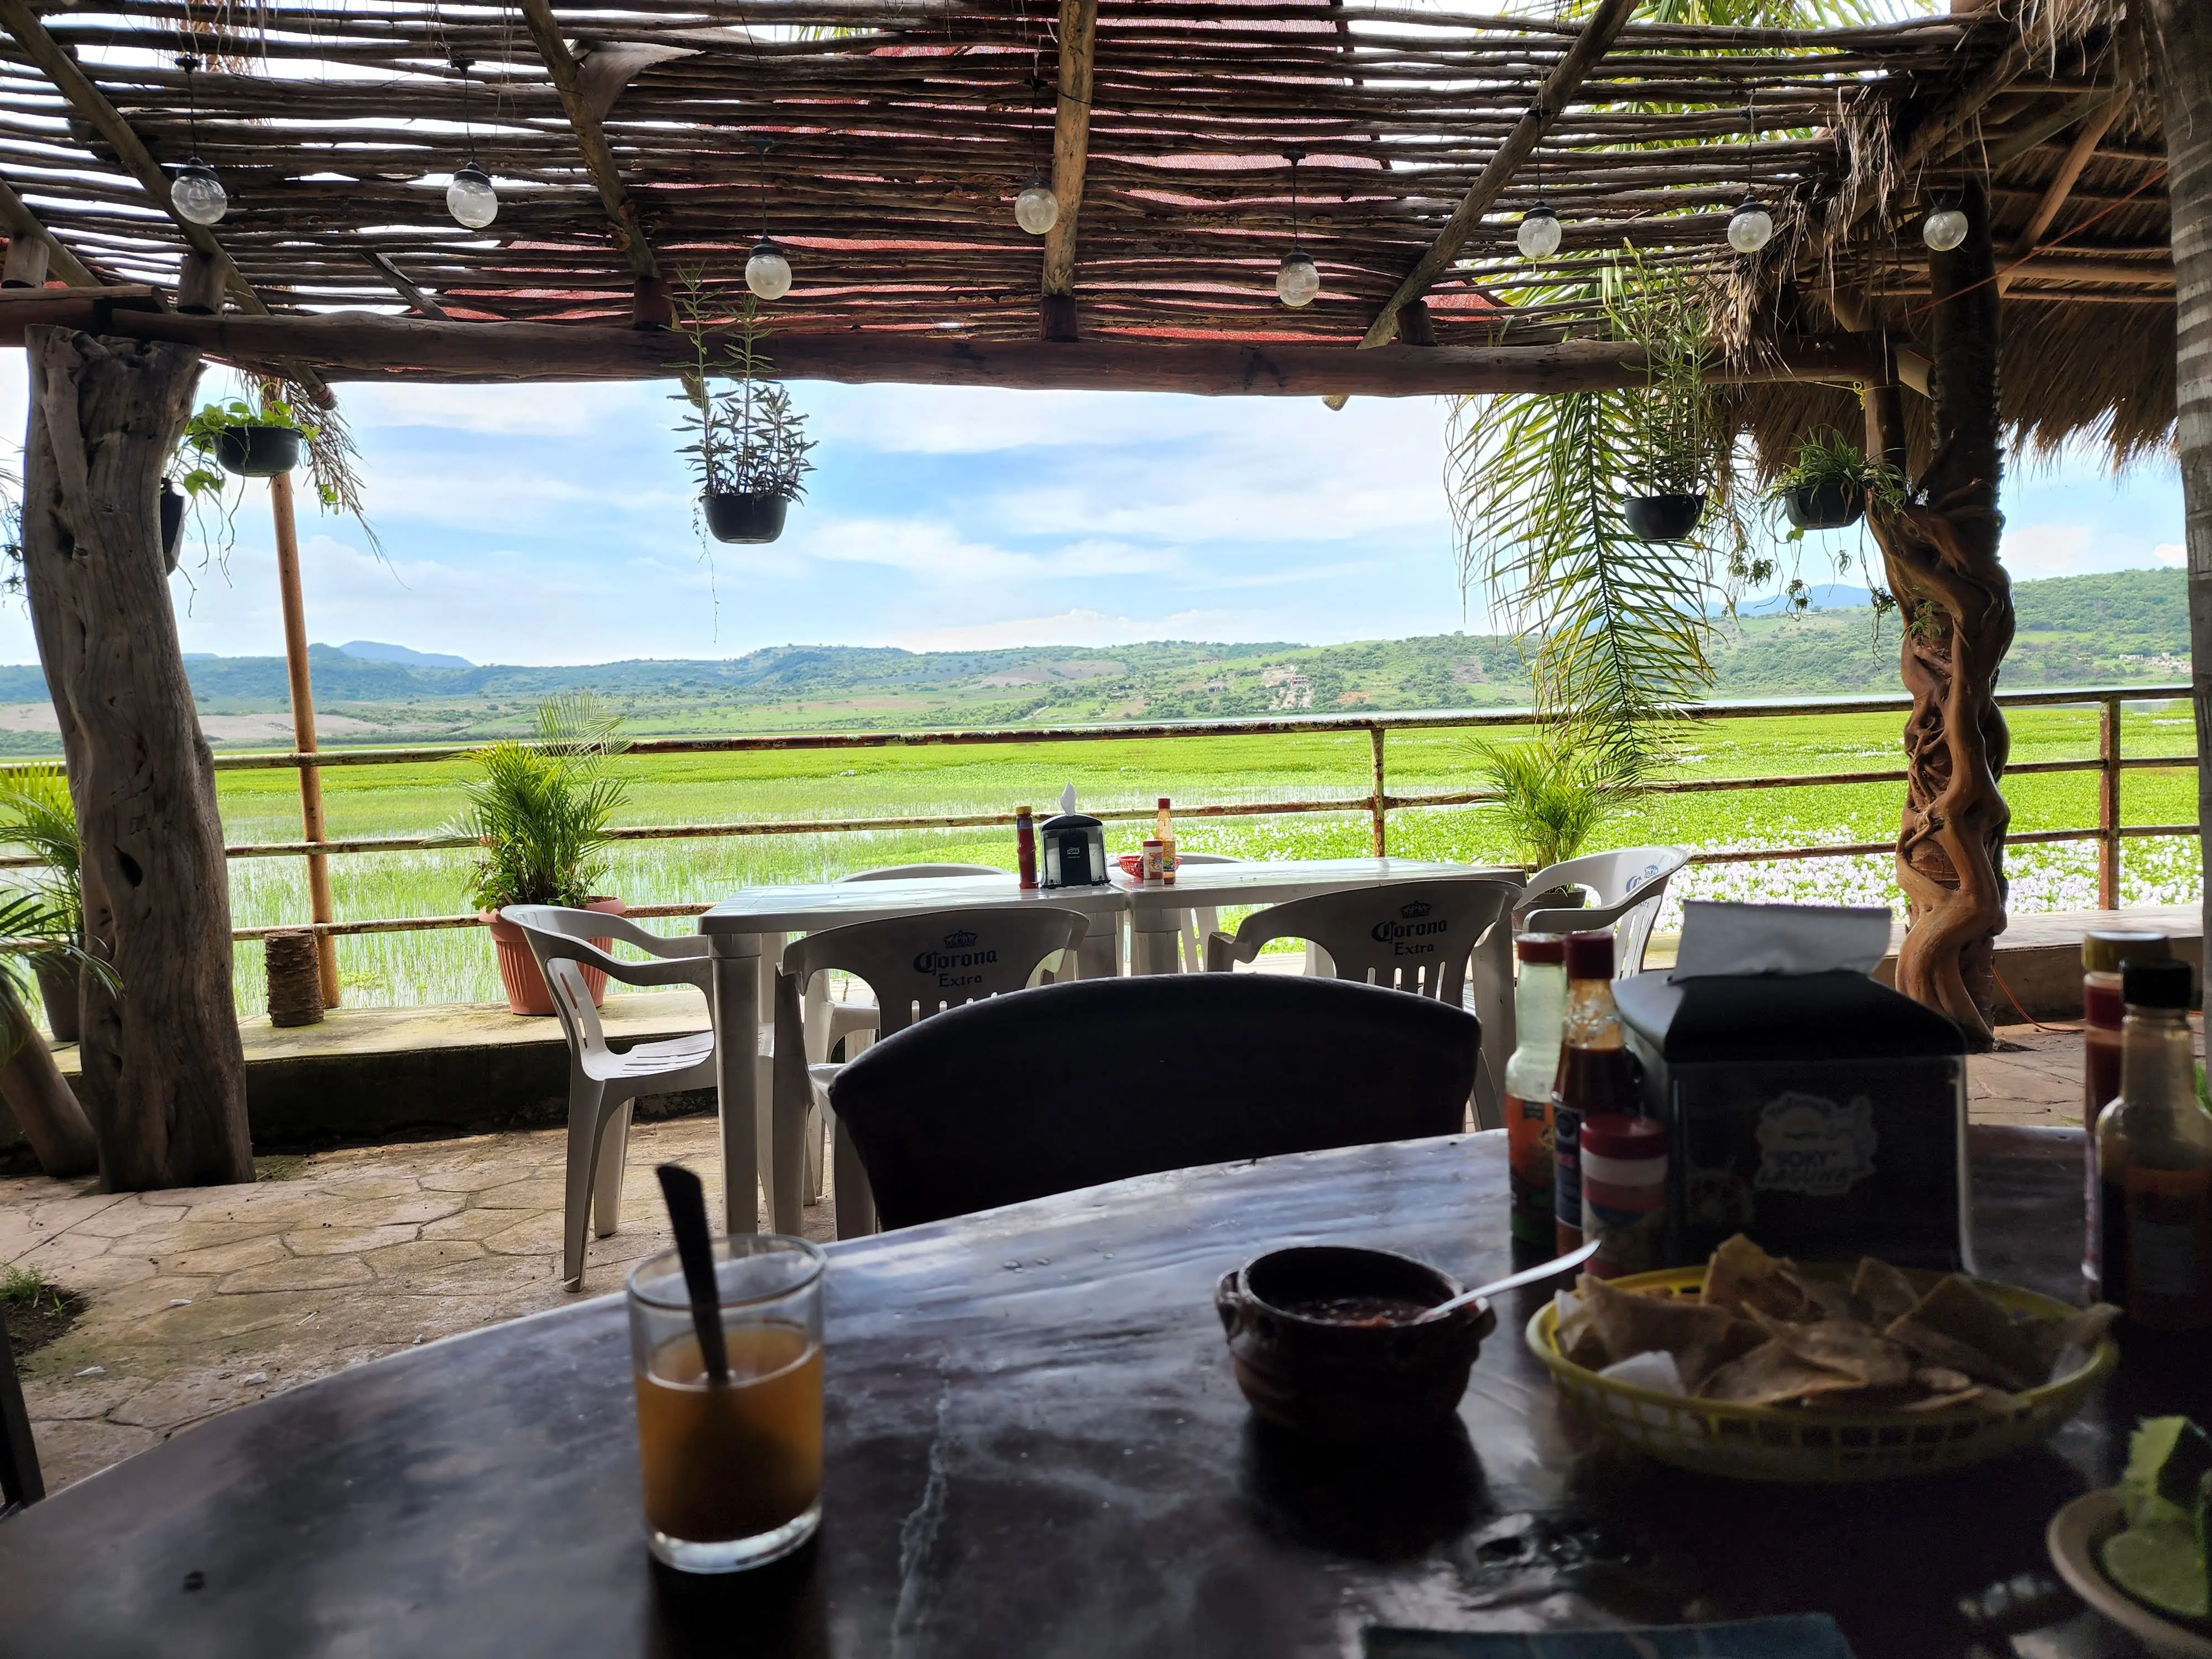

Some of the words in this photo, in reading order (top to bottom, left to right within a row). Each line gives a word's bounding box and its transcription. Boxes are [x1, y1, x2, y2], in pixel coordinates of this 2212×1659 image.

[1371, 920, 1447, 943] Corona
[1394, 942, 1434, 956] Extra
[913, 950, 998, 975] Corona
[938, 974, 982, 988] Extra
